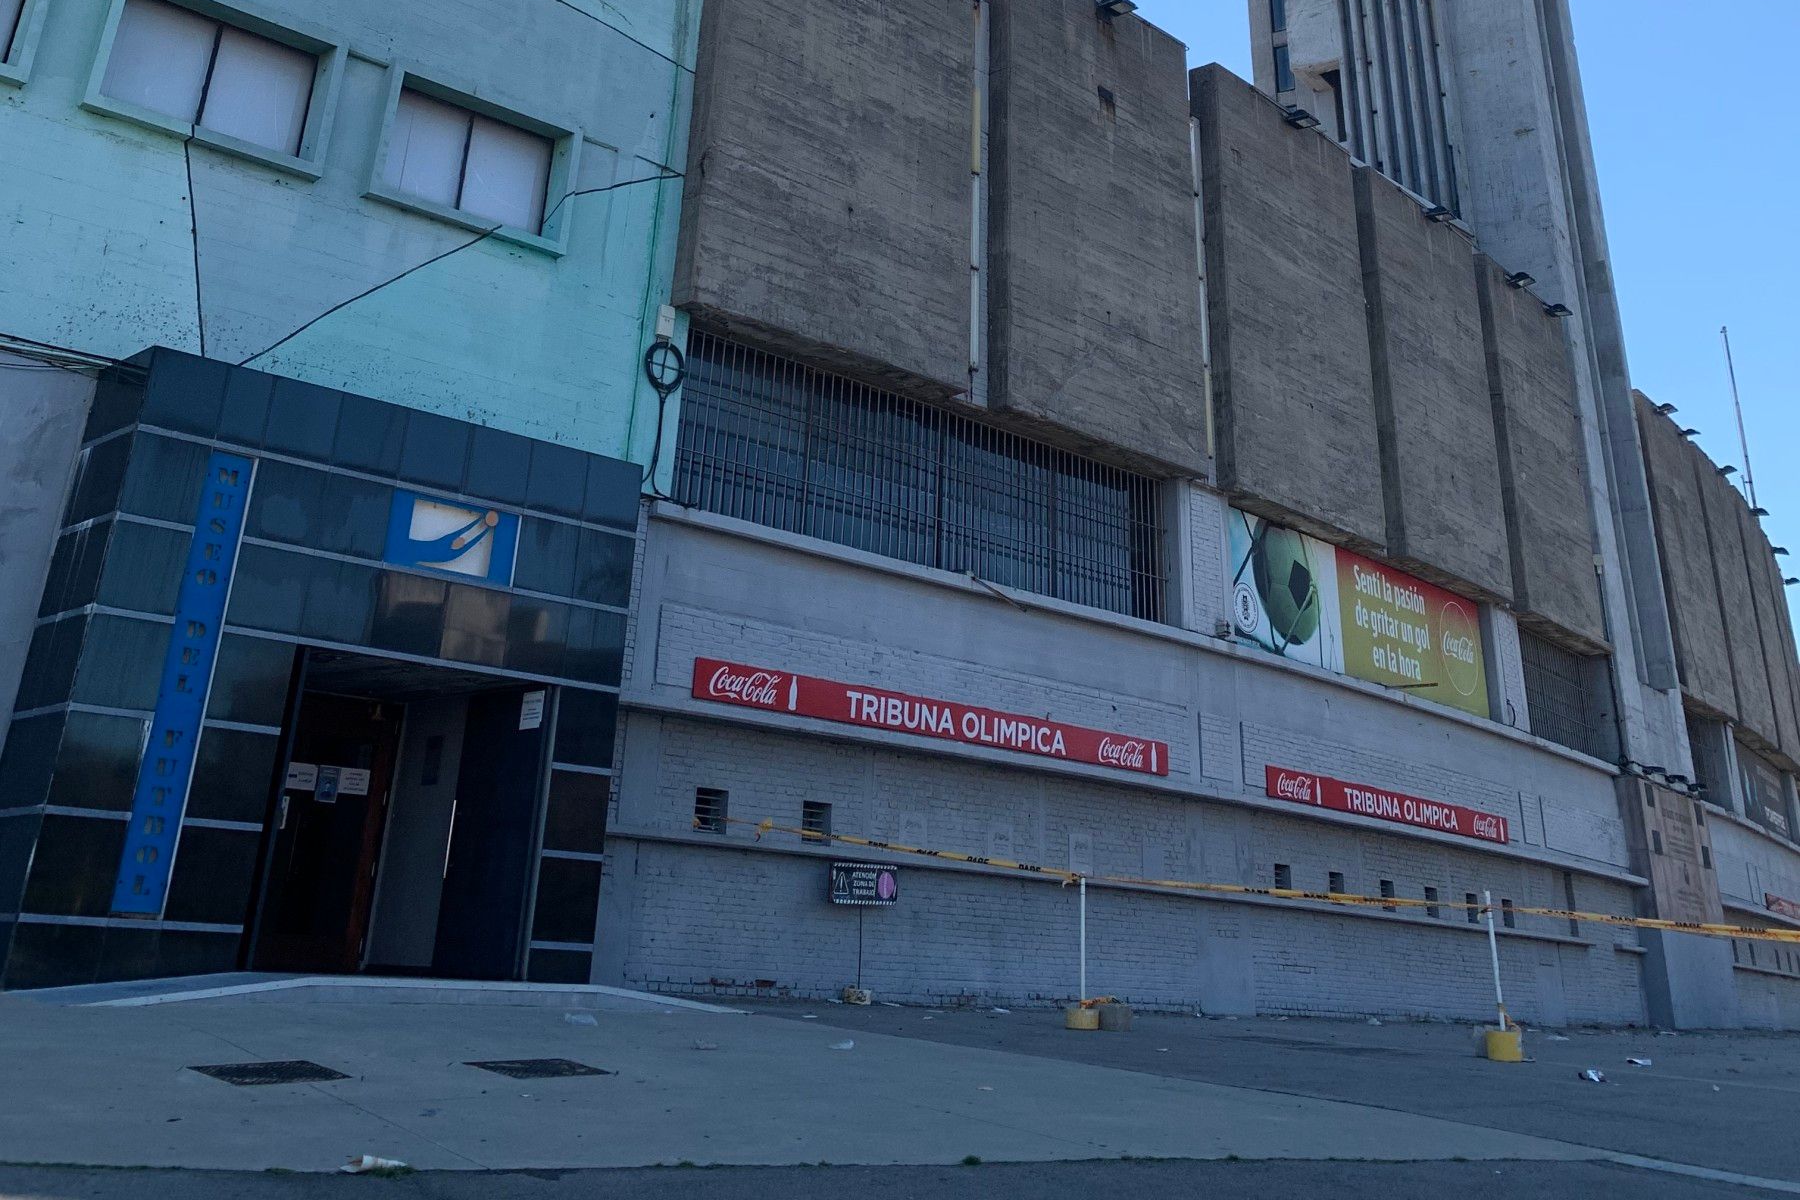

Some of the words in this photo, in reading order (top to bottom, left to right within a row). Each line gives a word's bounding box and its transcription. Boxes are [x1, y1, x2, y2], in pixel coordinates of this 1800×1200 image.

[197, 467, 238, 585] MUSEO
[1353, 564, 1381, 599] Sentí
[1382, 575, 1393, 604] la
[1394, 586, 1426, 616] pasión
[176, 620, 207, 694] DEL
[1355, 599, 1368, 629] de
[1370, 607, 1399, 639] gritar
[1401, 622, 1413, 645] un
[1415, 624, 1430, 653] gol
[1373, 645, 1386, 670] en
[1387, 644, 1398, 674] la
[1399, 648, 1422, 681] hora
[709, 666, 782, 705] Coca-Cola
[846, 690, 955, 735] TRIBUNA
[961, 711, 1066, 756] OLIMPICA
[1098, 736, 1145, 769] Coca-Cola
[132, 728, 183, 897] FUTBOL
[1344, 787, 1401, 818] TRIBUNA
[1403, 800, 1459, 831] OLIMPICA
